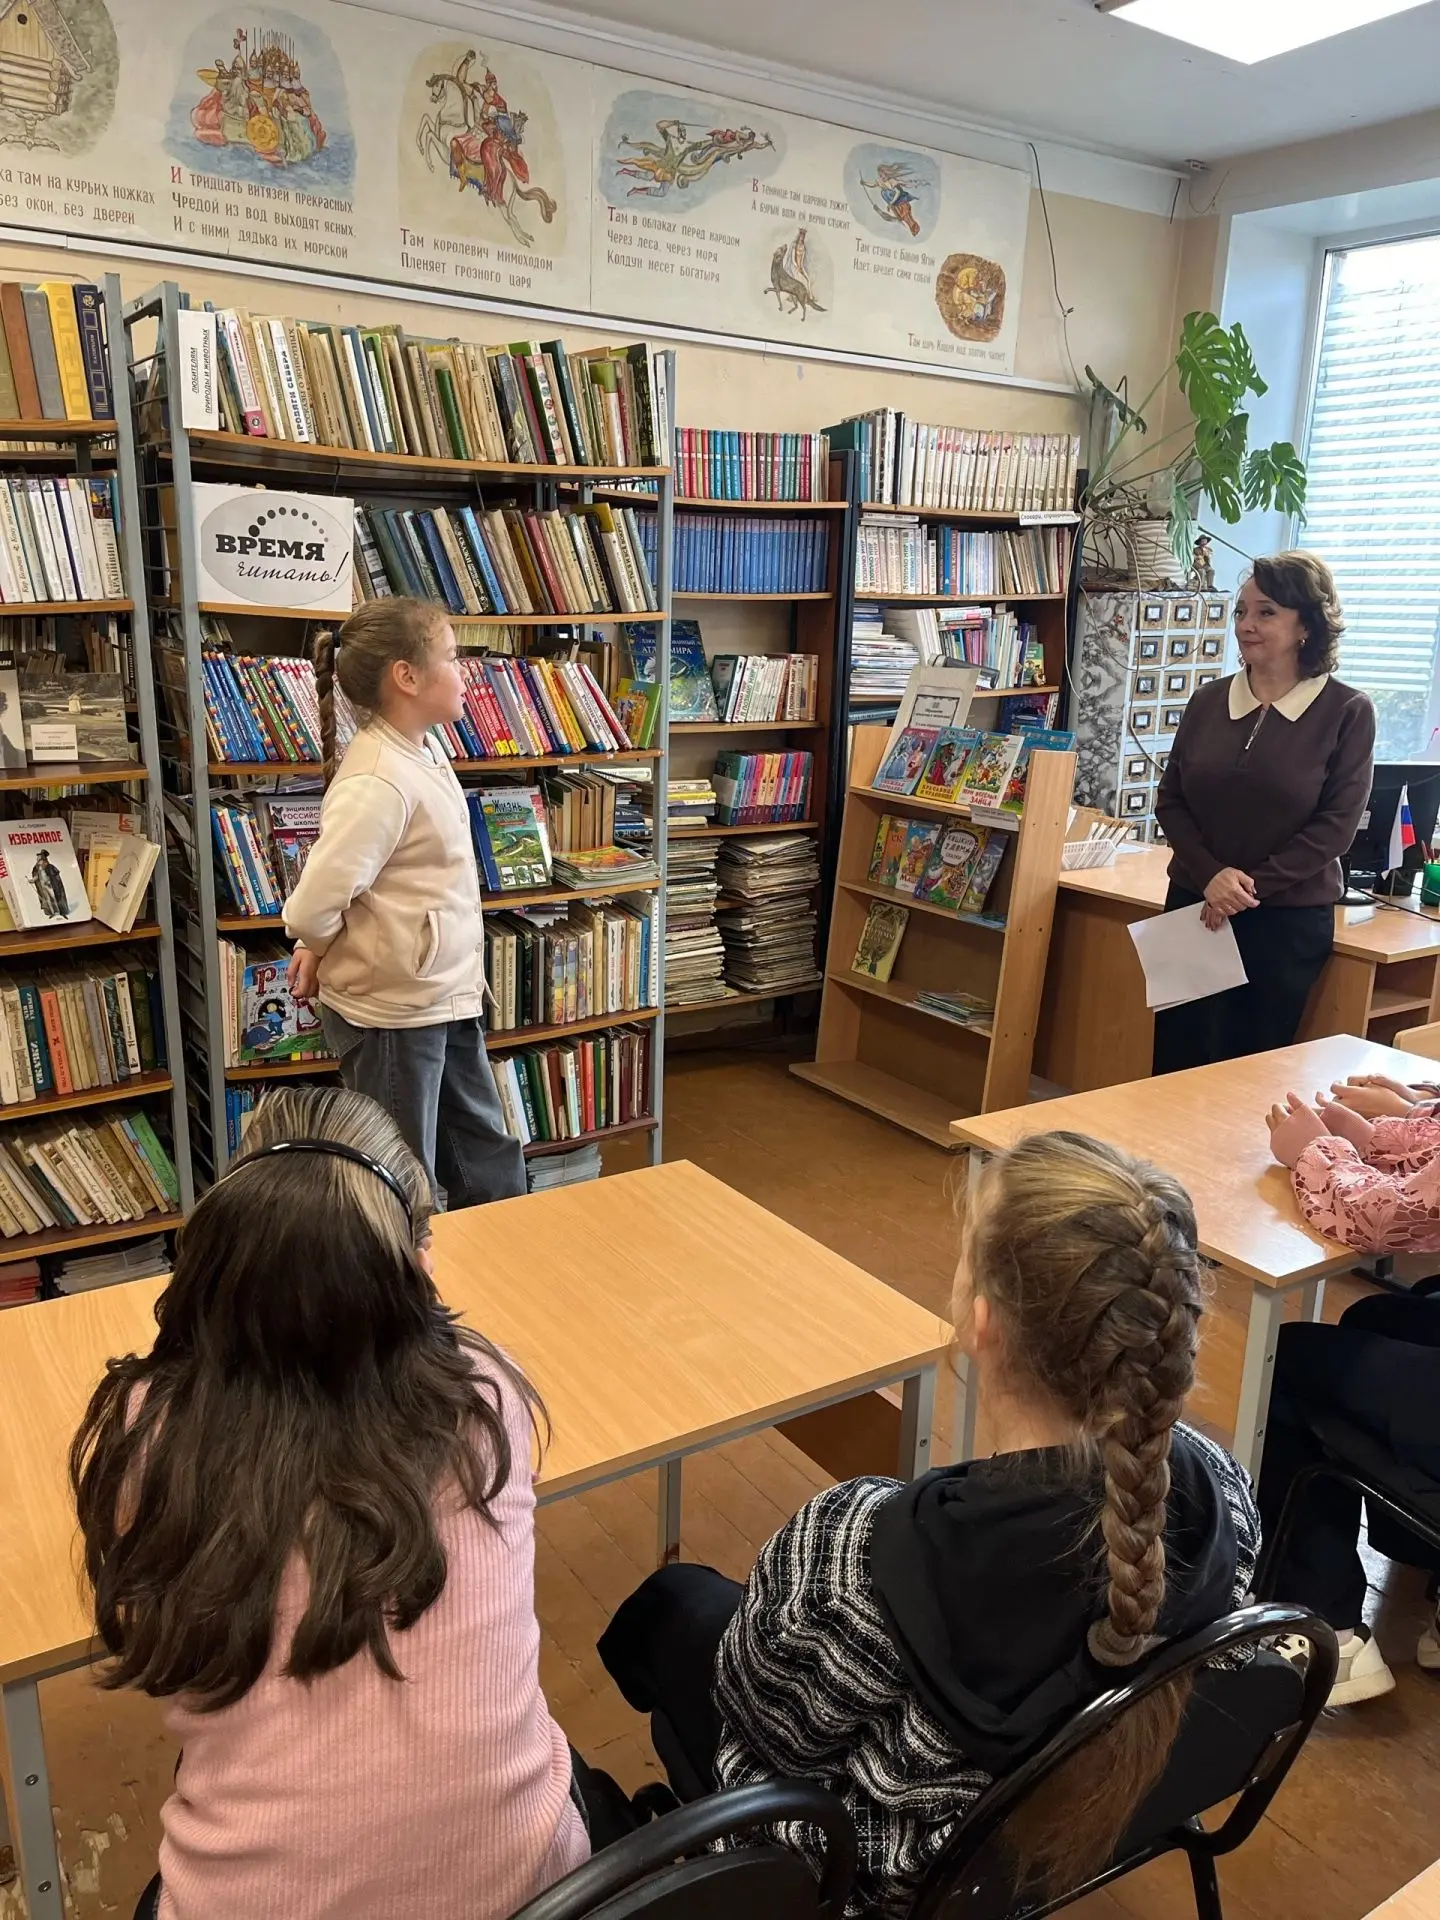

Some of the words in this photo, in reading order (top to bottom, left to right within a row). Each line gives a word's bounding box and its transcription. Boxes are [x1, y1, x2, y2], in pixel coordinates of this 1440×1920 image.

[170, 166, 182, 184] И
[281, 350, 294, 389] СЕВЕРА
[290, 391, 304, 436] БРОДЯГИ
[300, 390, 314, 434] РАССКАЗЫ
[215, 534, 325, 561] ВРЕМЯ
[237, 551, 349, 582] читать!
[8, 830, 64, 846] ИЗБРАННОЕ
